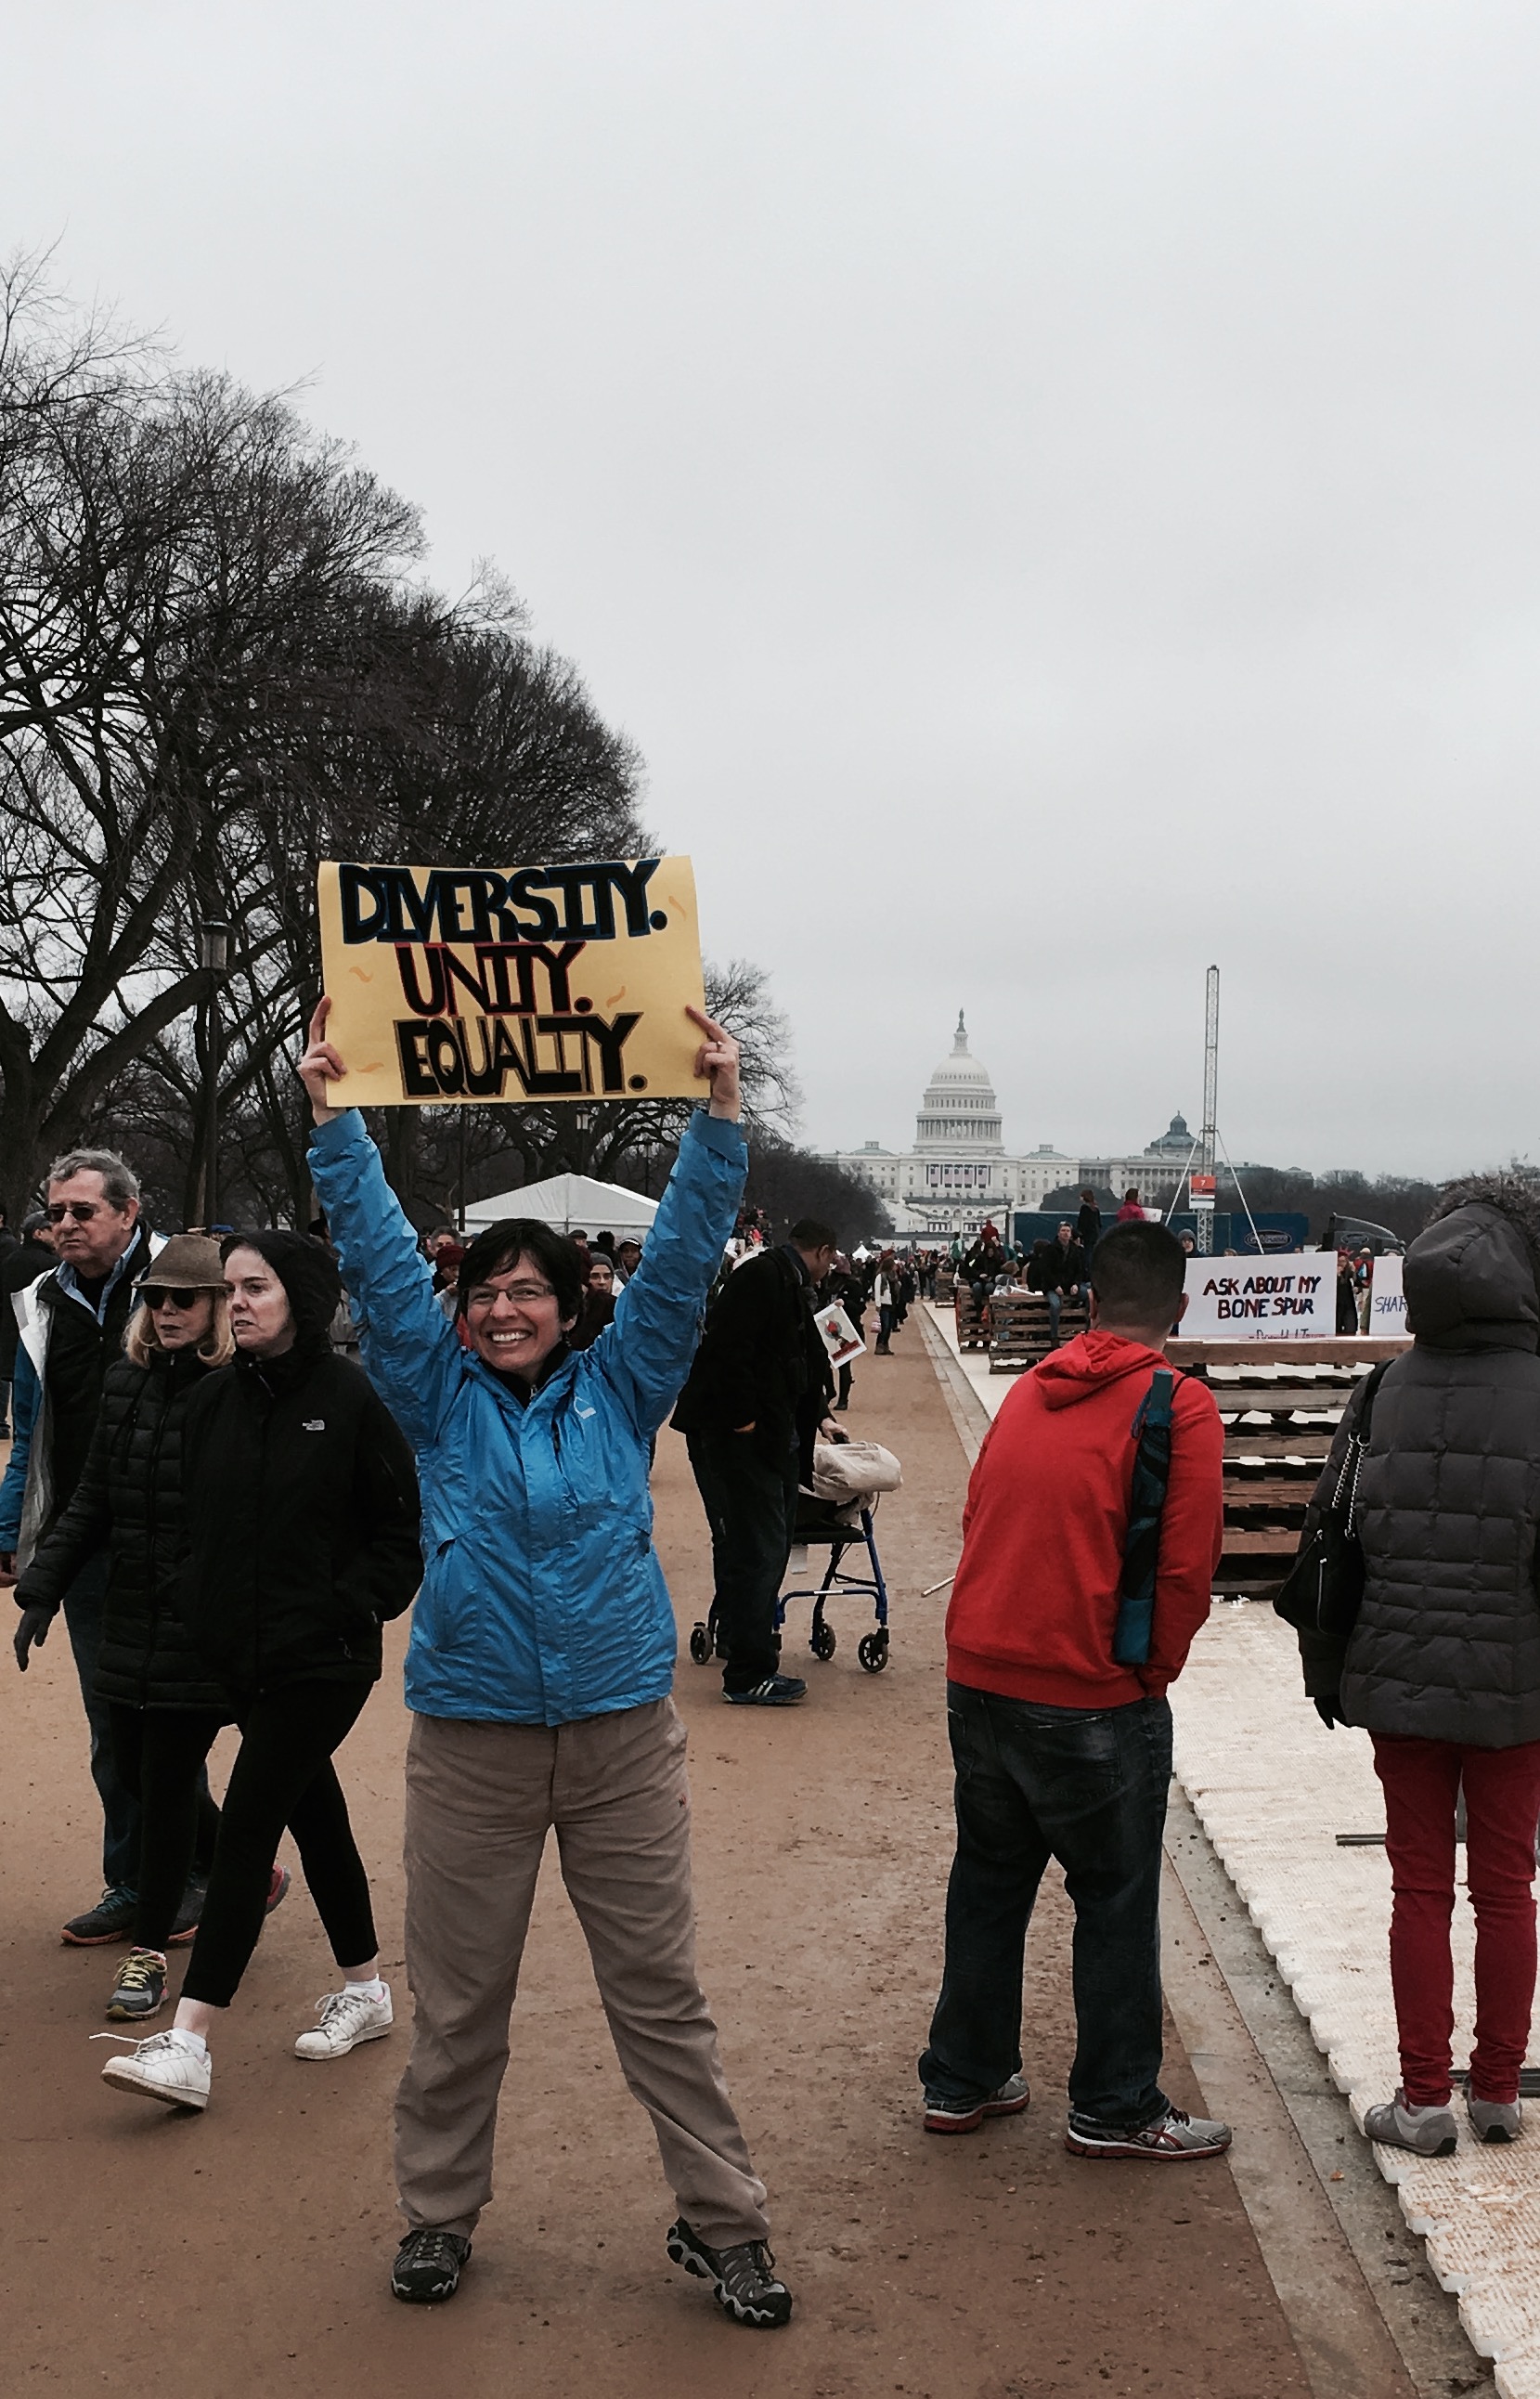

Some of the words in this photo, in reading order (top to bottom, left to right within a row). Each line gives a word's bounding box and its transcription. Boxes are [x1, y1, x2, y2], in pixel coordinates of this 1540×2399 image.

[339, 859, 667, 944] DIVERSITY.
[395, 941, 594, 1018] UNITY.
[393, 1012, 648, 1099] EQUALITY.
[1202, 1277, 1240, 1296] ASK
[1243, 1276, 1296, 1294] ABOUT
[1298, 1276, 1322, 1293] MY
[1218, 1298, 1270, 1319] BONE
[1272, 1297, 1314, 1316] SPUR
